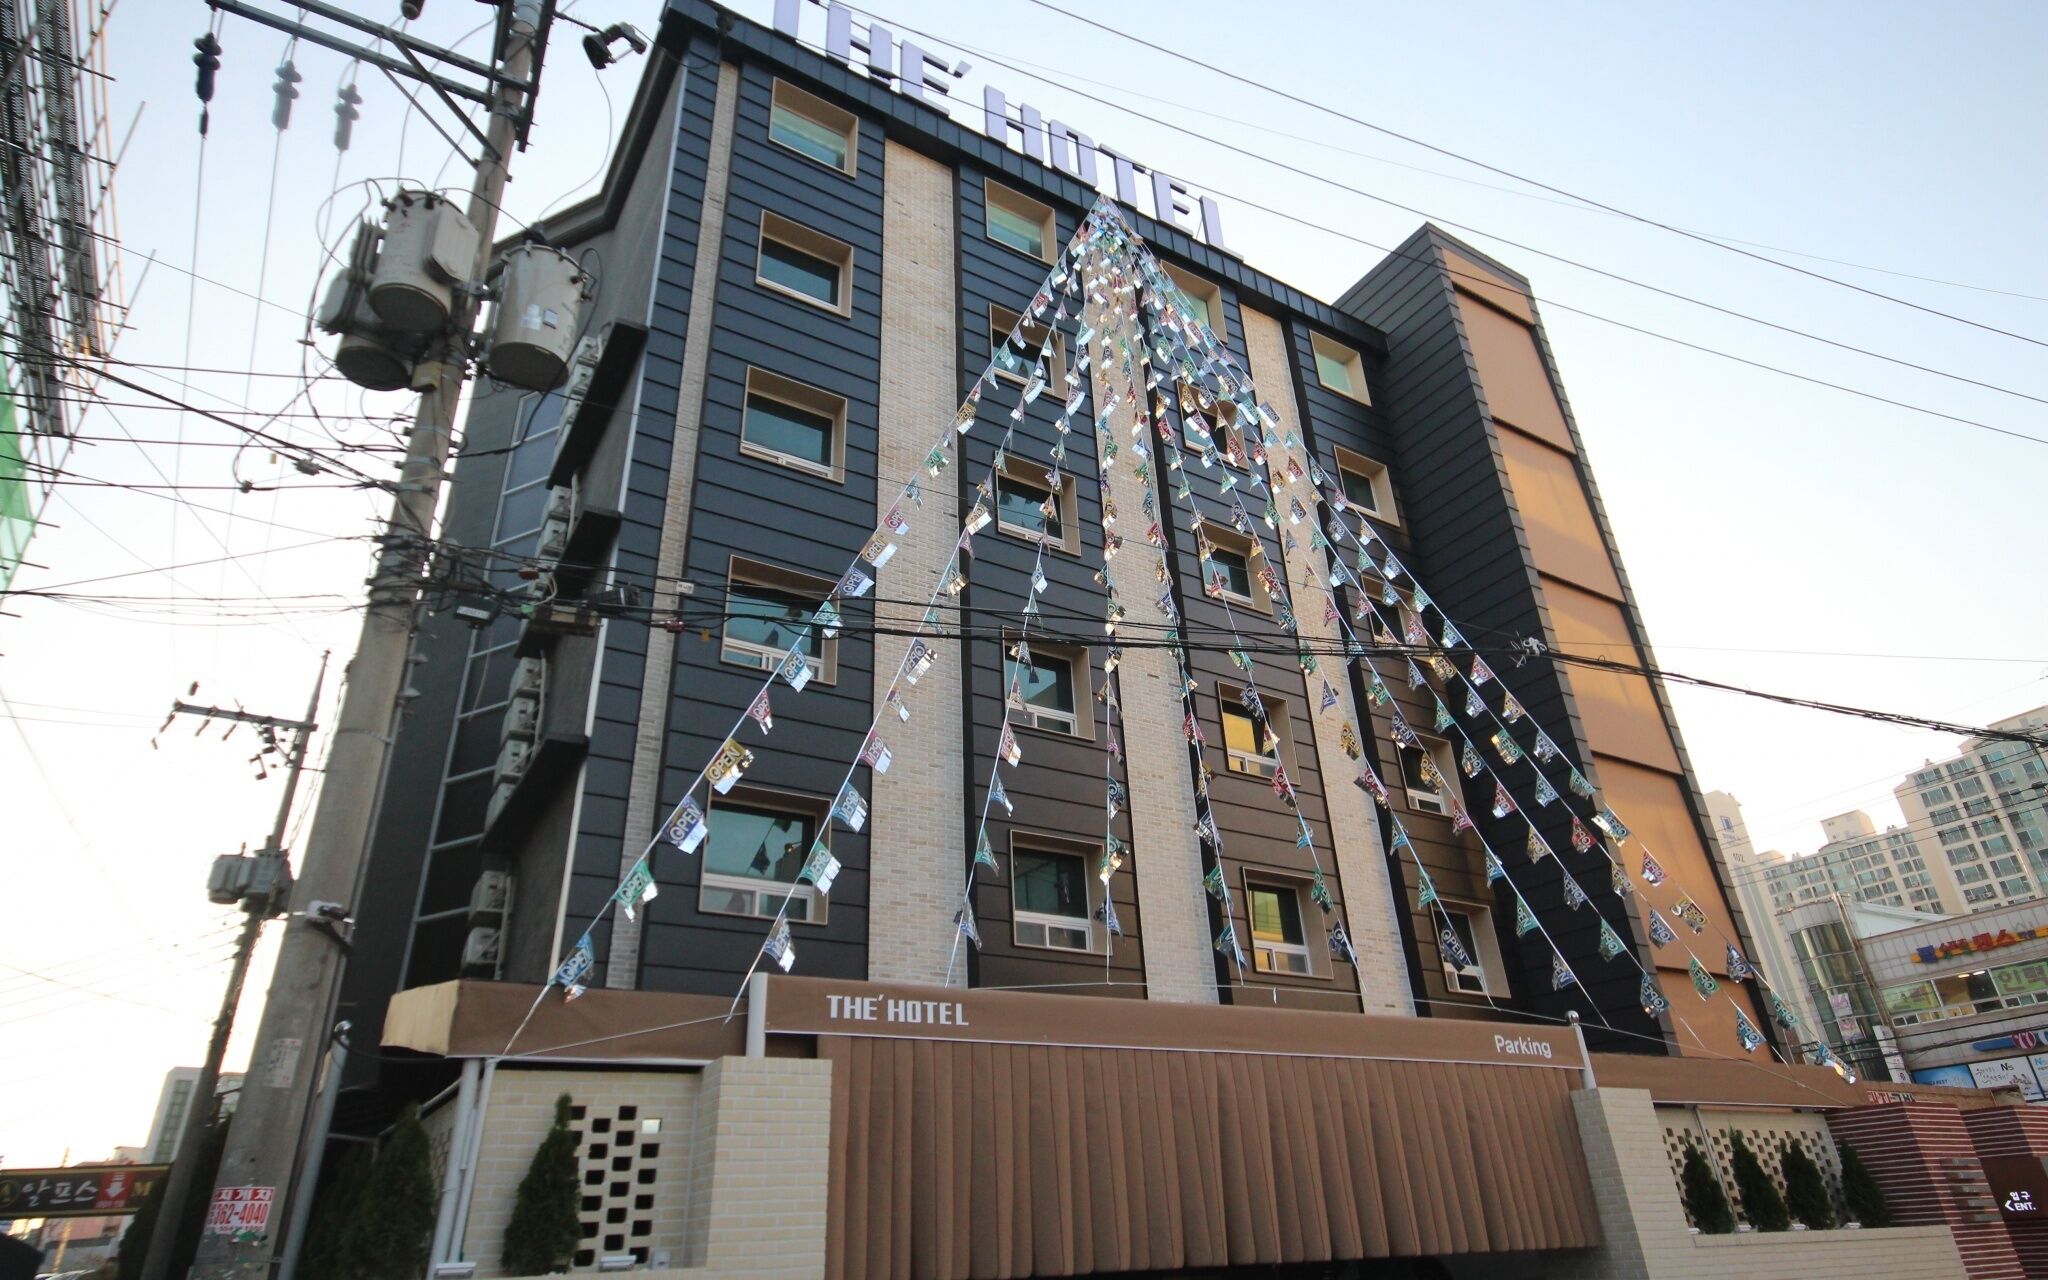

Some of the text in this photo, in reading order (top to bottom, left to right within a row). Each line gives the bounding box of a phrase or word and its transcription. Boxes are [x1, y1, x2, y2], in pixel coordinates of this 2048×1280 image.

[984, 84, 1245, 264] HOTEL
[865, 538, 887, 561] OPEN
[842, 570, 867, 594] OPEN
[1392, 716, 1416, 741] OPEN
[708, 746, 741, 780] OPEN
[668, 803, 702, 842] OPEN
[619, 870, 648, 904] OPEN
[1440, 928, 1467, 962] OPEN
[558, 945, 590, 981] OPEN
[887, 999, 969, 1026] HOTEL
[1494, 1034, 1552, 1059] Parking
